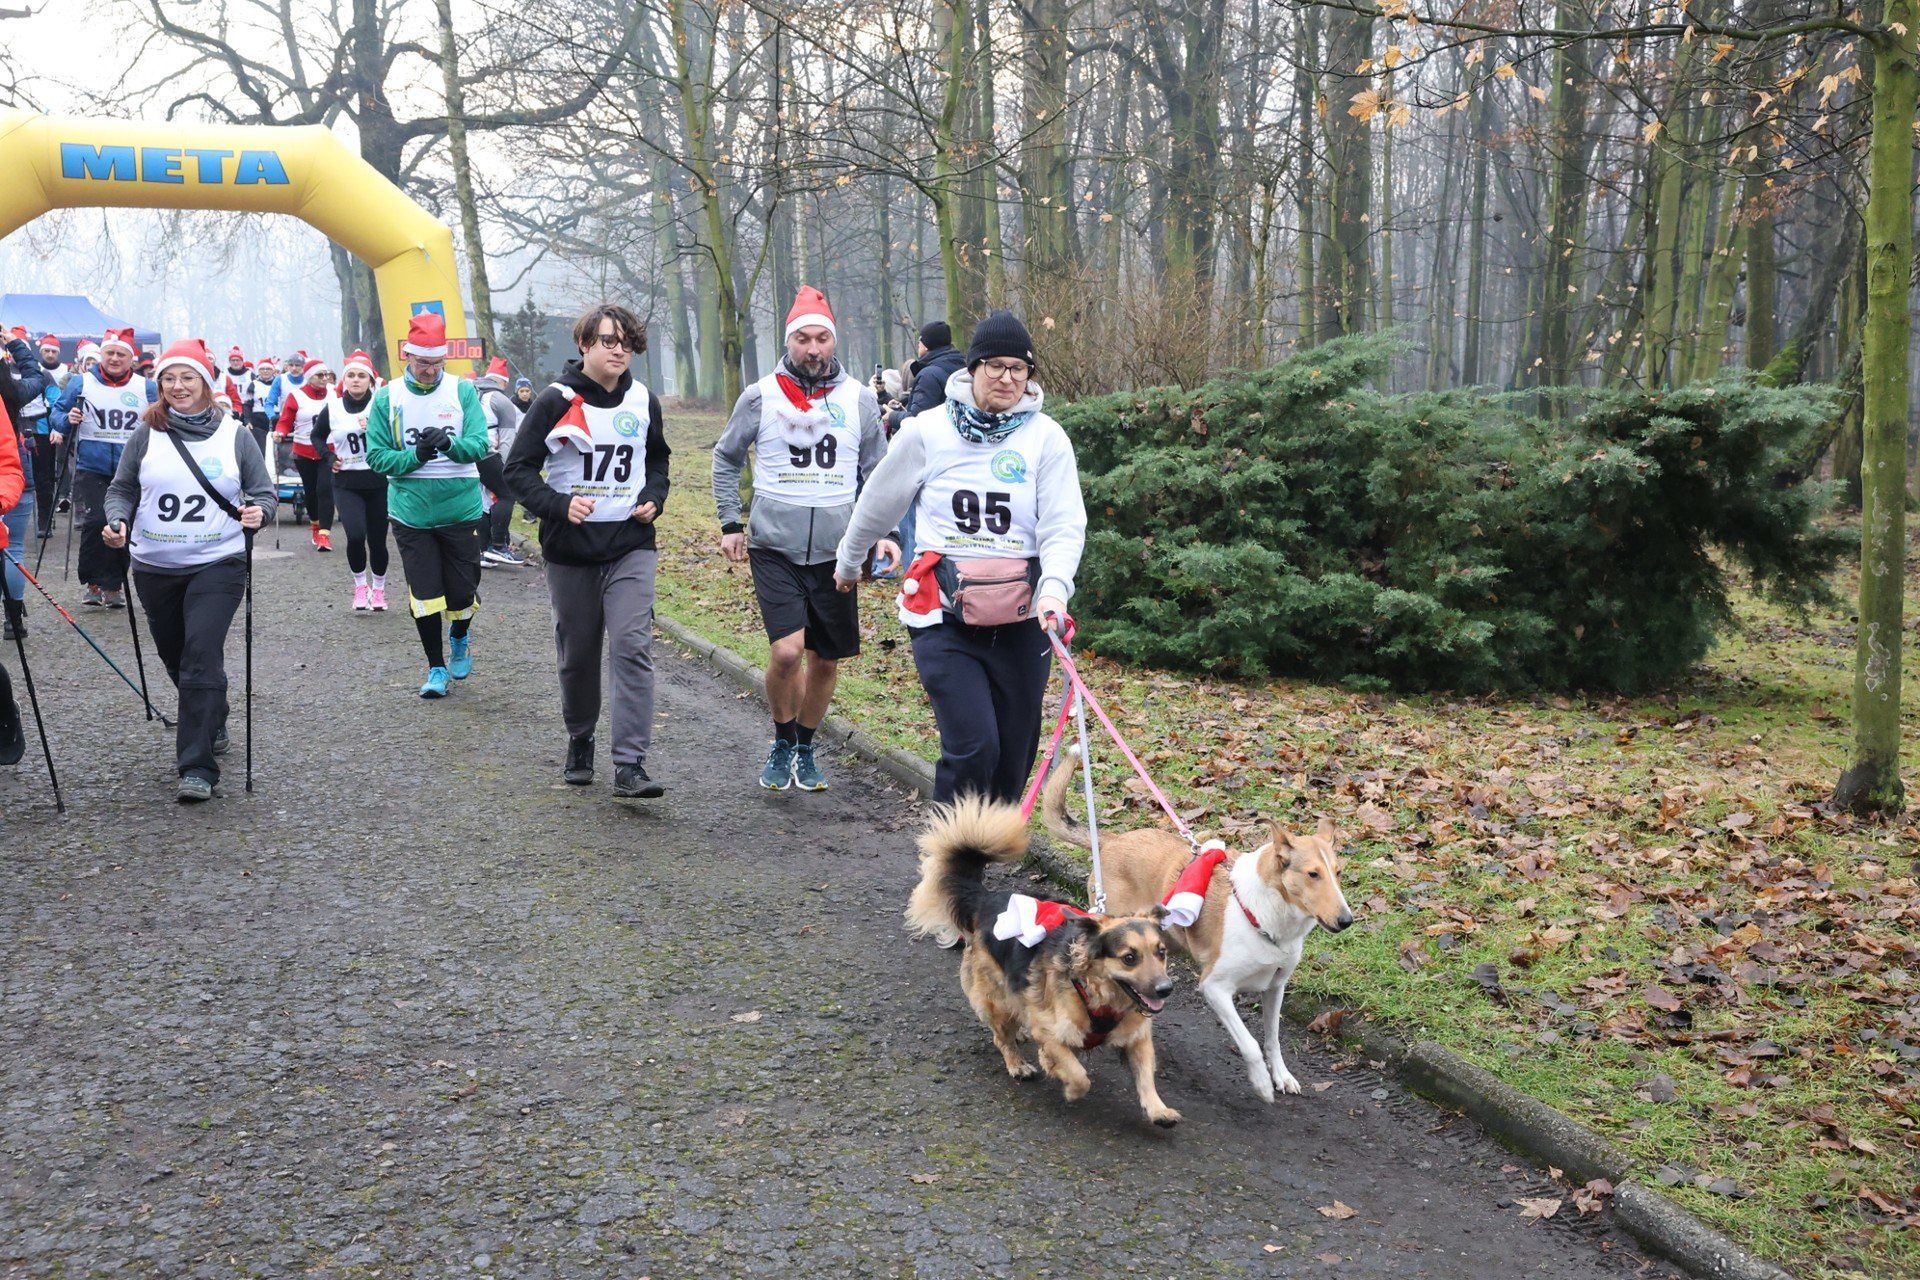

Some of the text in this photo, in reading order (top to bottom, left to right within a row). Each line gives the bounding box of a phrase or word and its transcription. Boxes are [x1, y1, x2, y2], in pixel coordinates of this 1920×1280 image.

[60, 142, 290, 185] META
[95, 409, 138, 431] 182
[578, 444, 634, 483] 173
[788, 433, 838, 470] 98
[157, 493, 207, 523] 92
[952, 489, 1012, 536] 95
